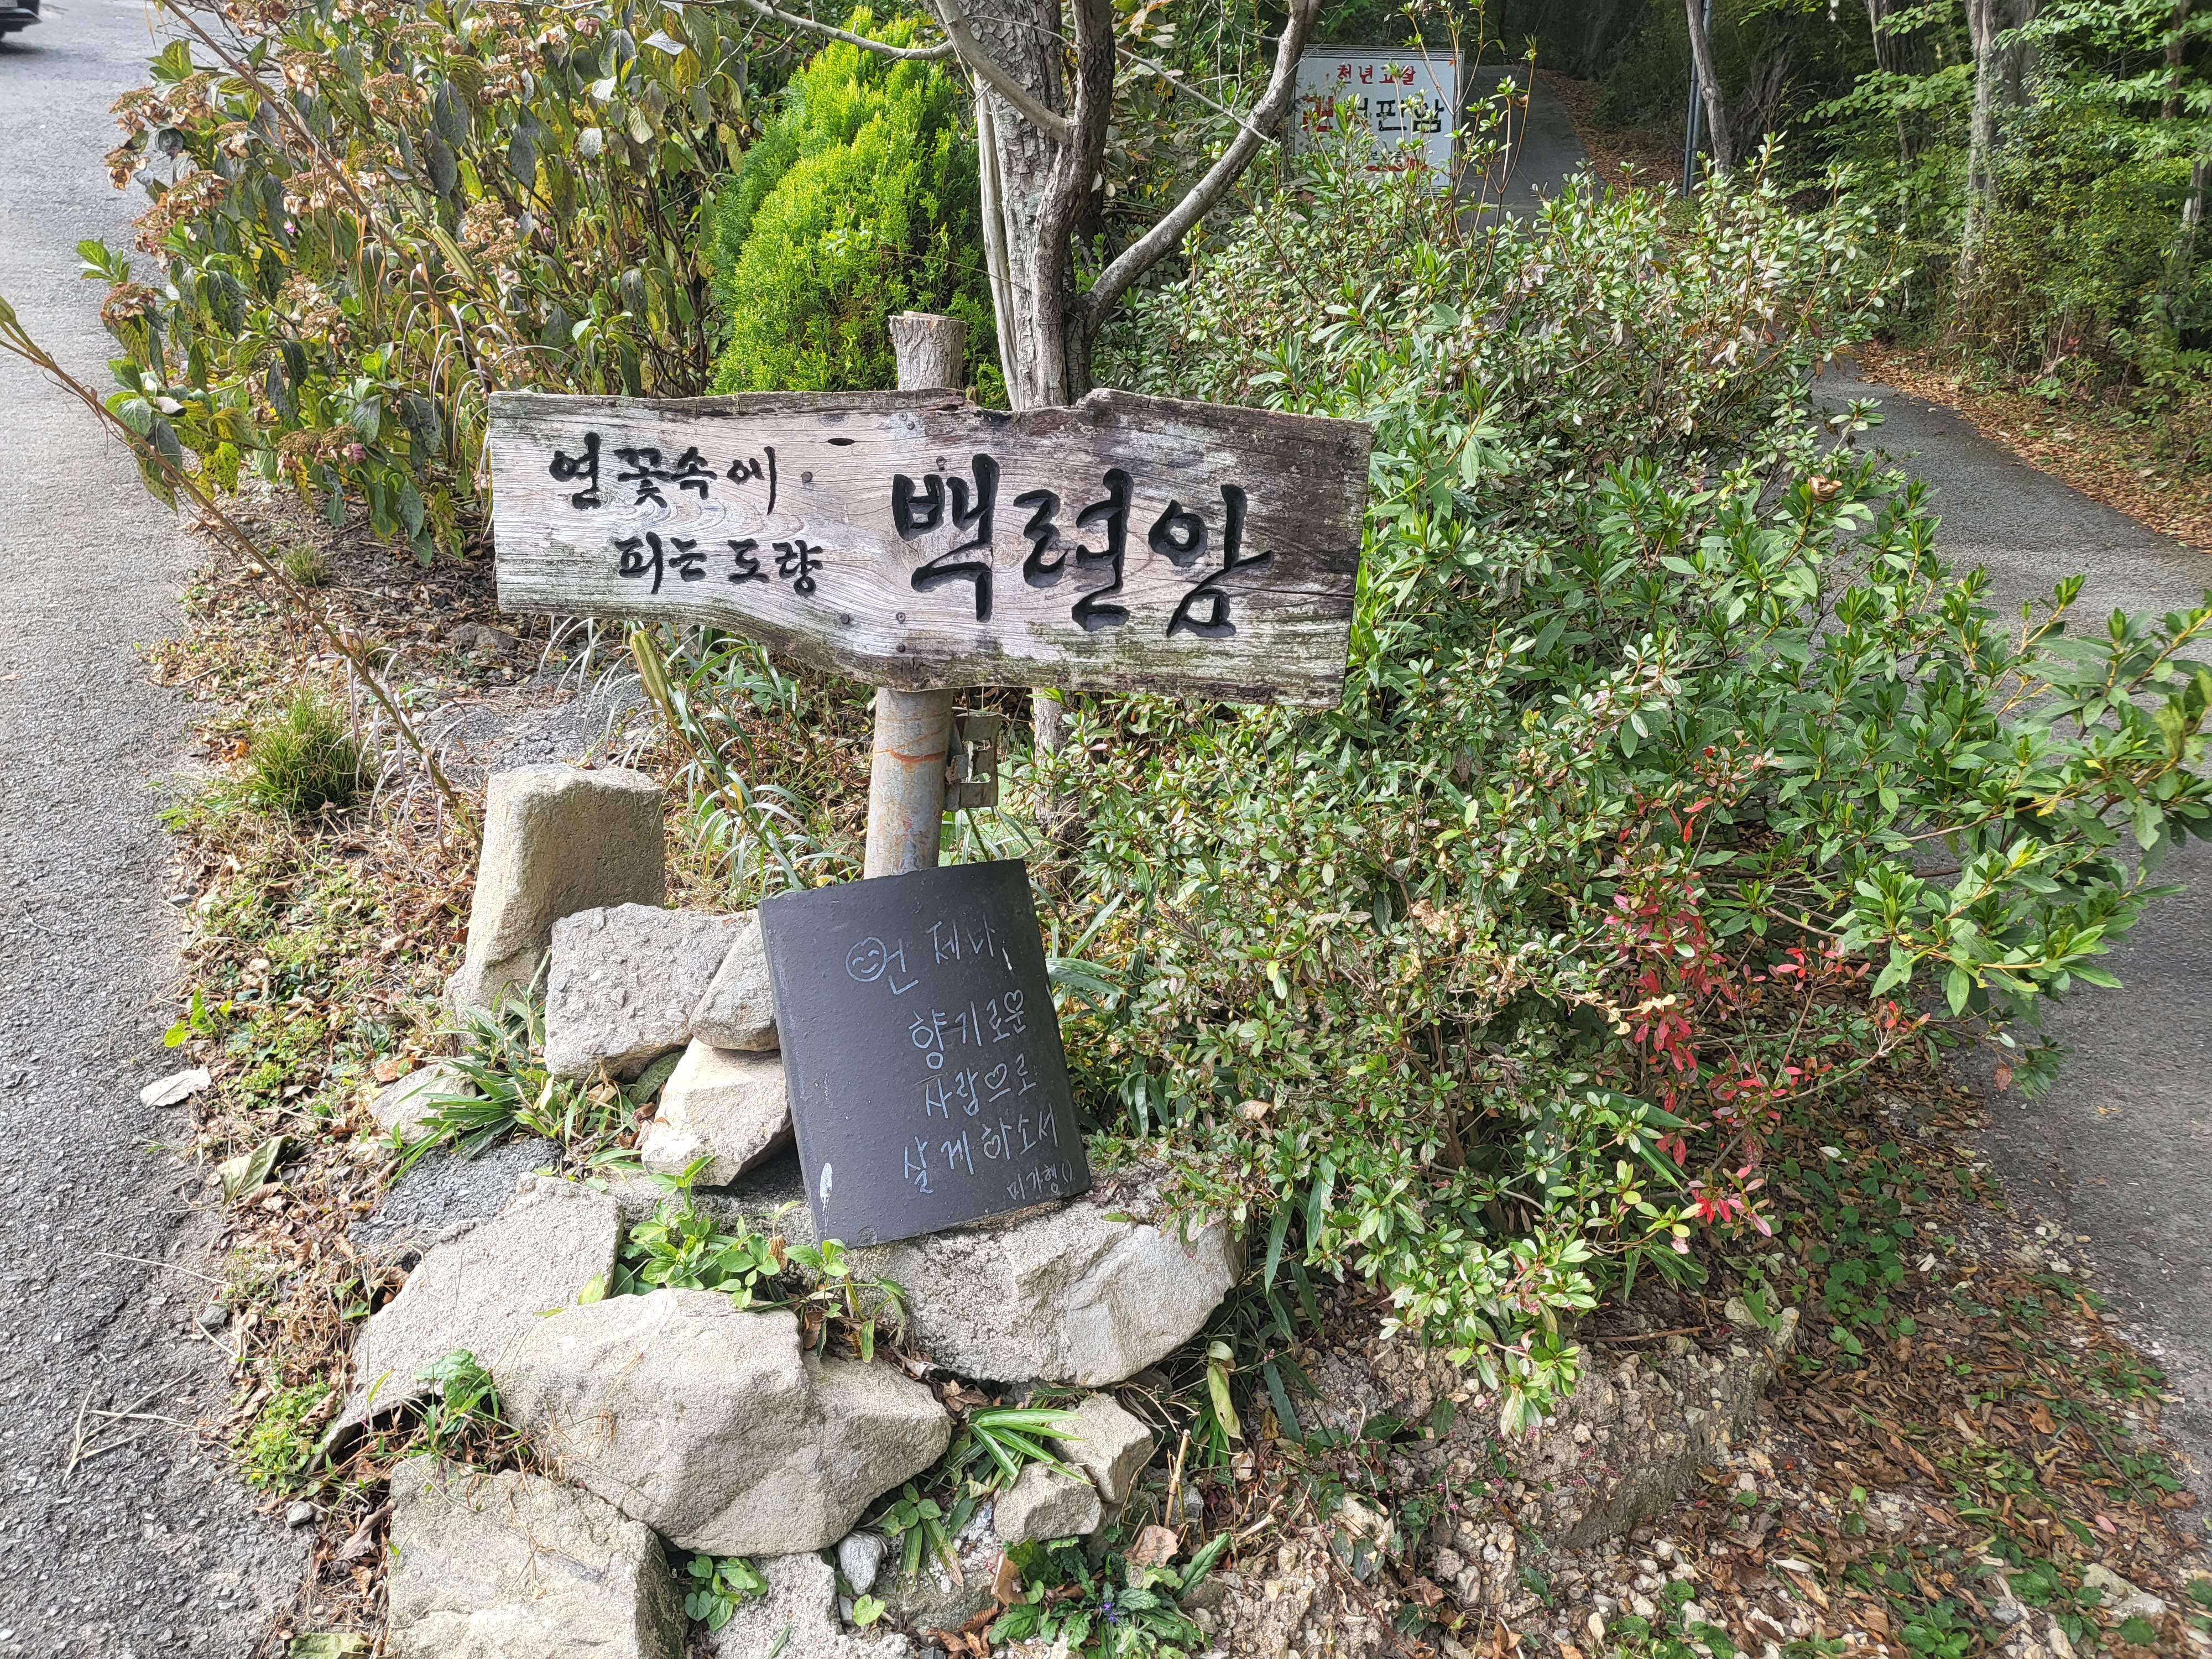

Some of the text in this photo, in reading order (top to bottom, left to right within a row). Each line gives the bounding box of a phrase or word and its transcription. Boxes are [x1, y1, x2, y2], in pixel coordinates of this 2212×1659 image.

[891, 453, 1274, 638] 백련암
[908, 989, 1026, 1070] 향기로운
[925, 1052, 1037, 1119] 사랑으로
